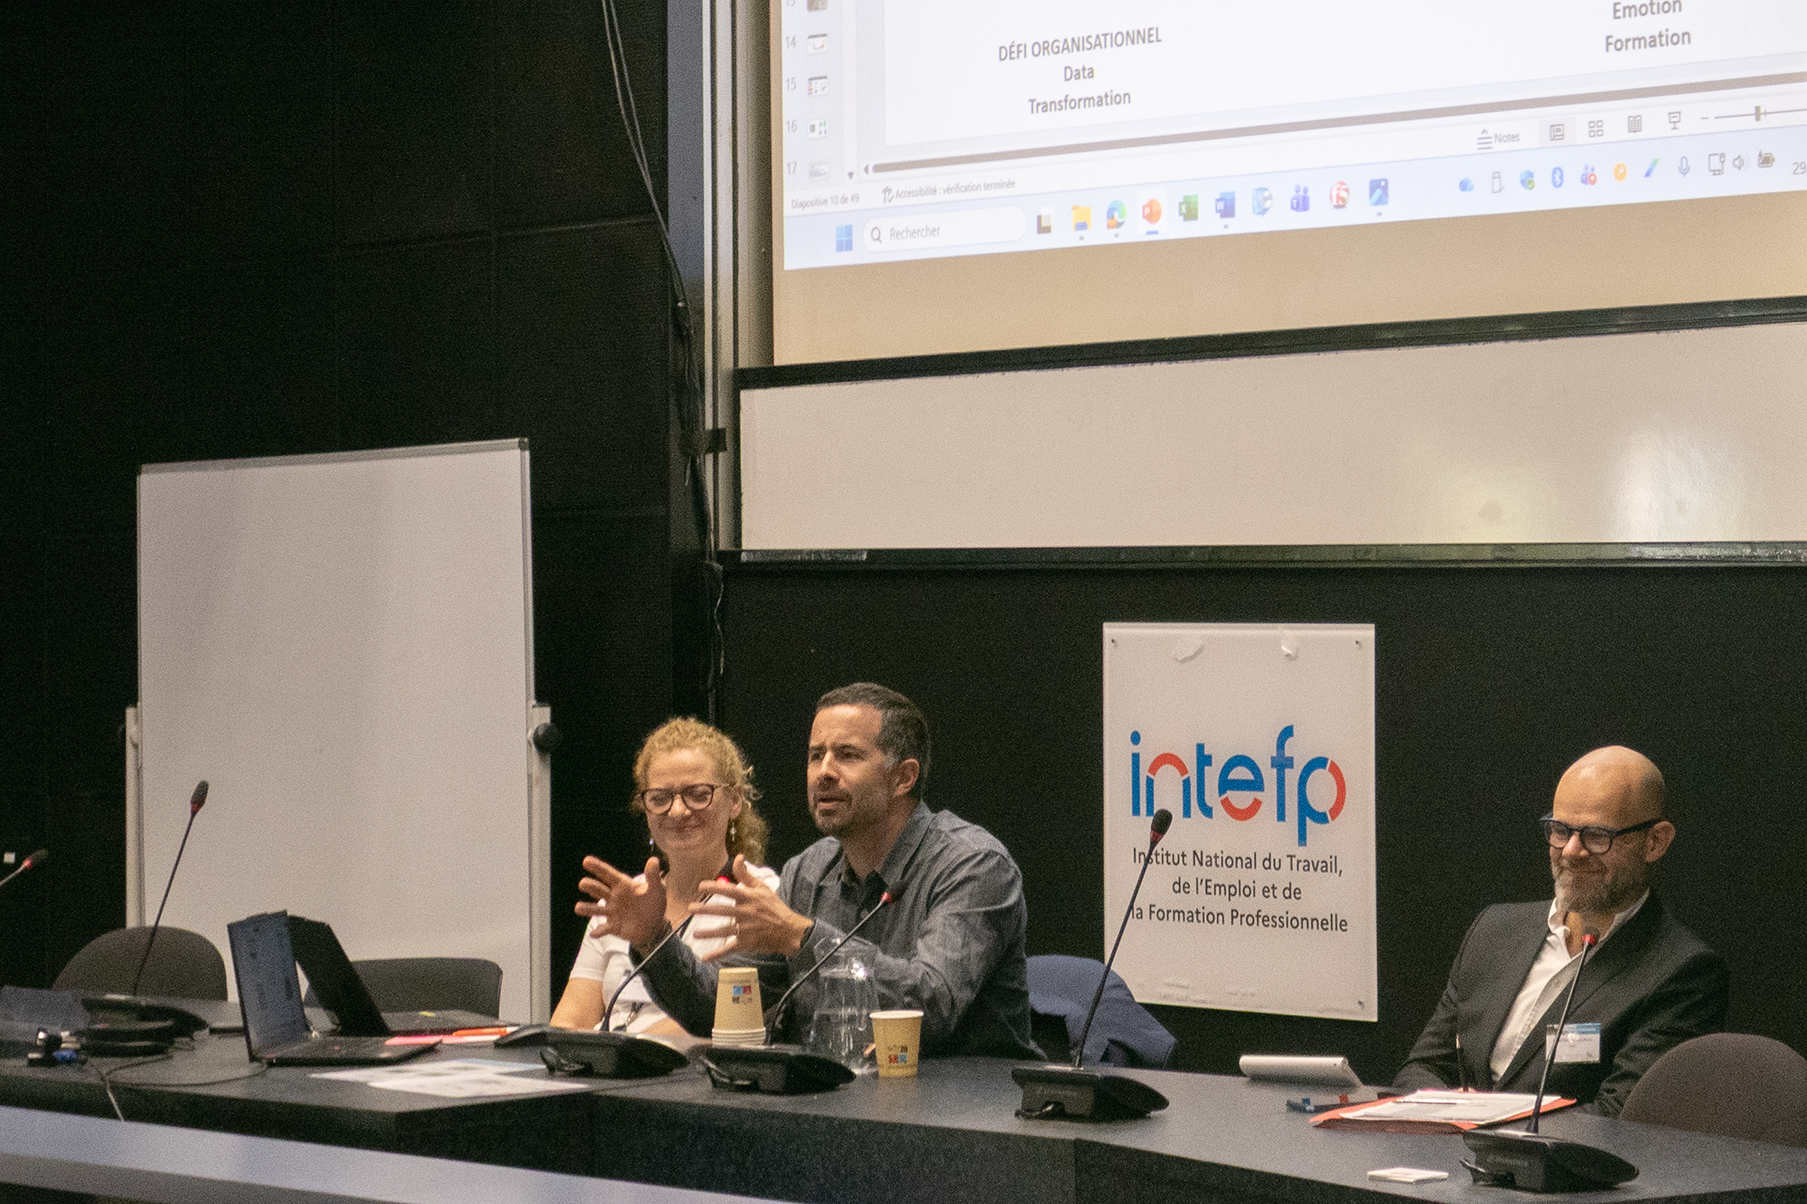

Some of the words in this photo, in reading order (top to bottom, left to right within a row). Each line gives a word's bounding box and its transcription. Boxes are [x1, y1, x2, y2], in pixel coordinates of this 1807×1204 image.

[1613, 0, 1683, 20] Emotion
[785, 34, 796, 49] 14
[999, 40, 1027, 62] DÉFI
[1031, 26, 1163, 58] ORGANISATIONNEL
[1605, 28, 1692, 53] Formation
[1064, 64, 1095, 82] Data
[786, 76, 797, 91] 15
[1028, 89, 1132, 115] Transformation
[786, 118, 798, 133] 16
[1494, 133, 1520, 143] Notes
[786, 161, 798, 175] 17
[895, 186, 938, 199] Accessibilité
[942, 182, 982, 195] vérification
[983, 178, 1016, 190] terminée
[791, 196, 829, 211] Diapositive
[830, 195, 839, 205] 10
[840, 193, 849, 204] de
[850, 192, 860, 203] 49
[889, 225, 941, 241] Rechercher
[1130, 724, 1347, 847] intefp
[1132, 847, 1187, 867] Institut
[1192, 849, 1257, 870] National
[1262, 852, 1282, 871] du
[1286, 854, 1343, 877] Travail,
[1172, 876, 1191, 895] de
[1195, 877, 1256, 902] l'Emploi
[1262, 882, 1278, 899] et
[1282, 882, 1302, 901] de
[1131, 904, 1143, 920] la
[1148, 903, 1225, 926] Formation
[1230, 908, 1348, 932] Professionnelle
